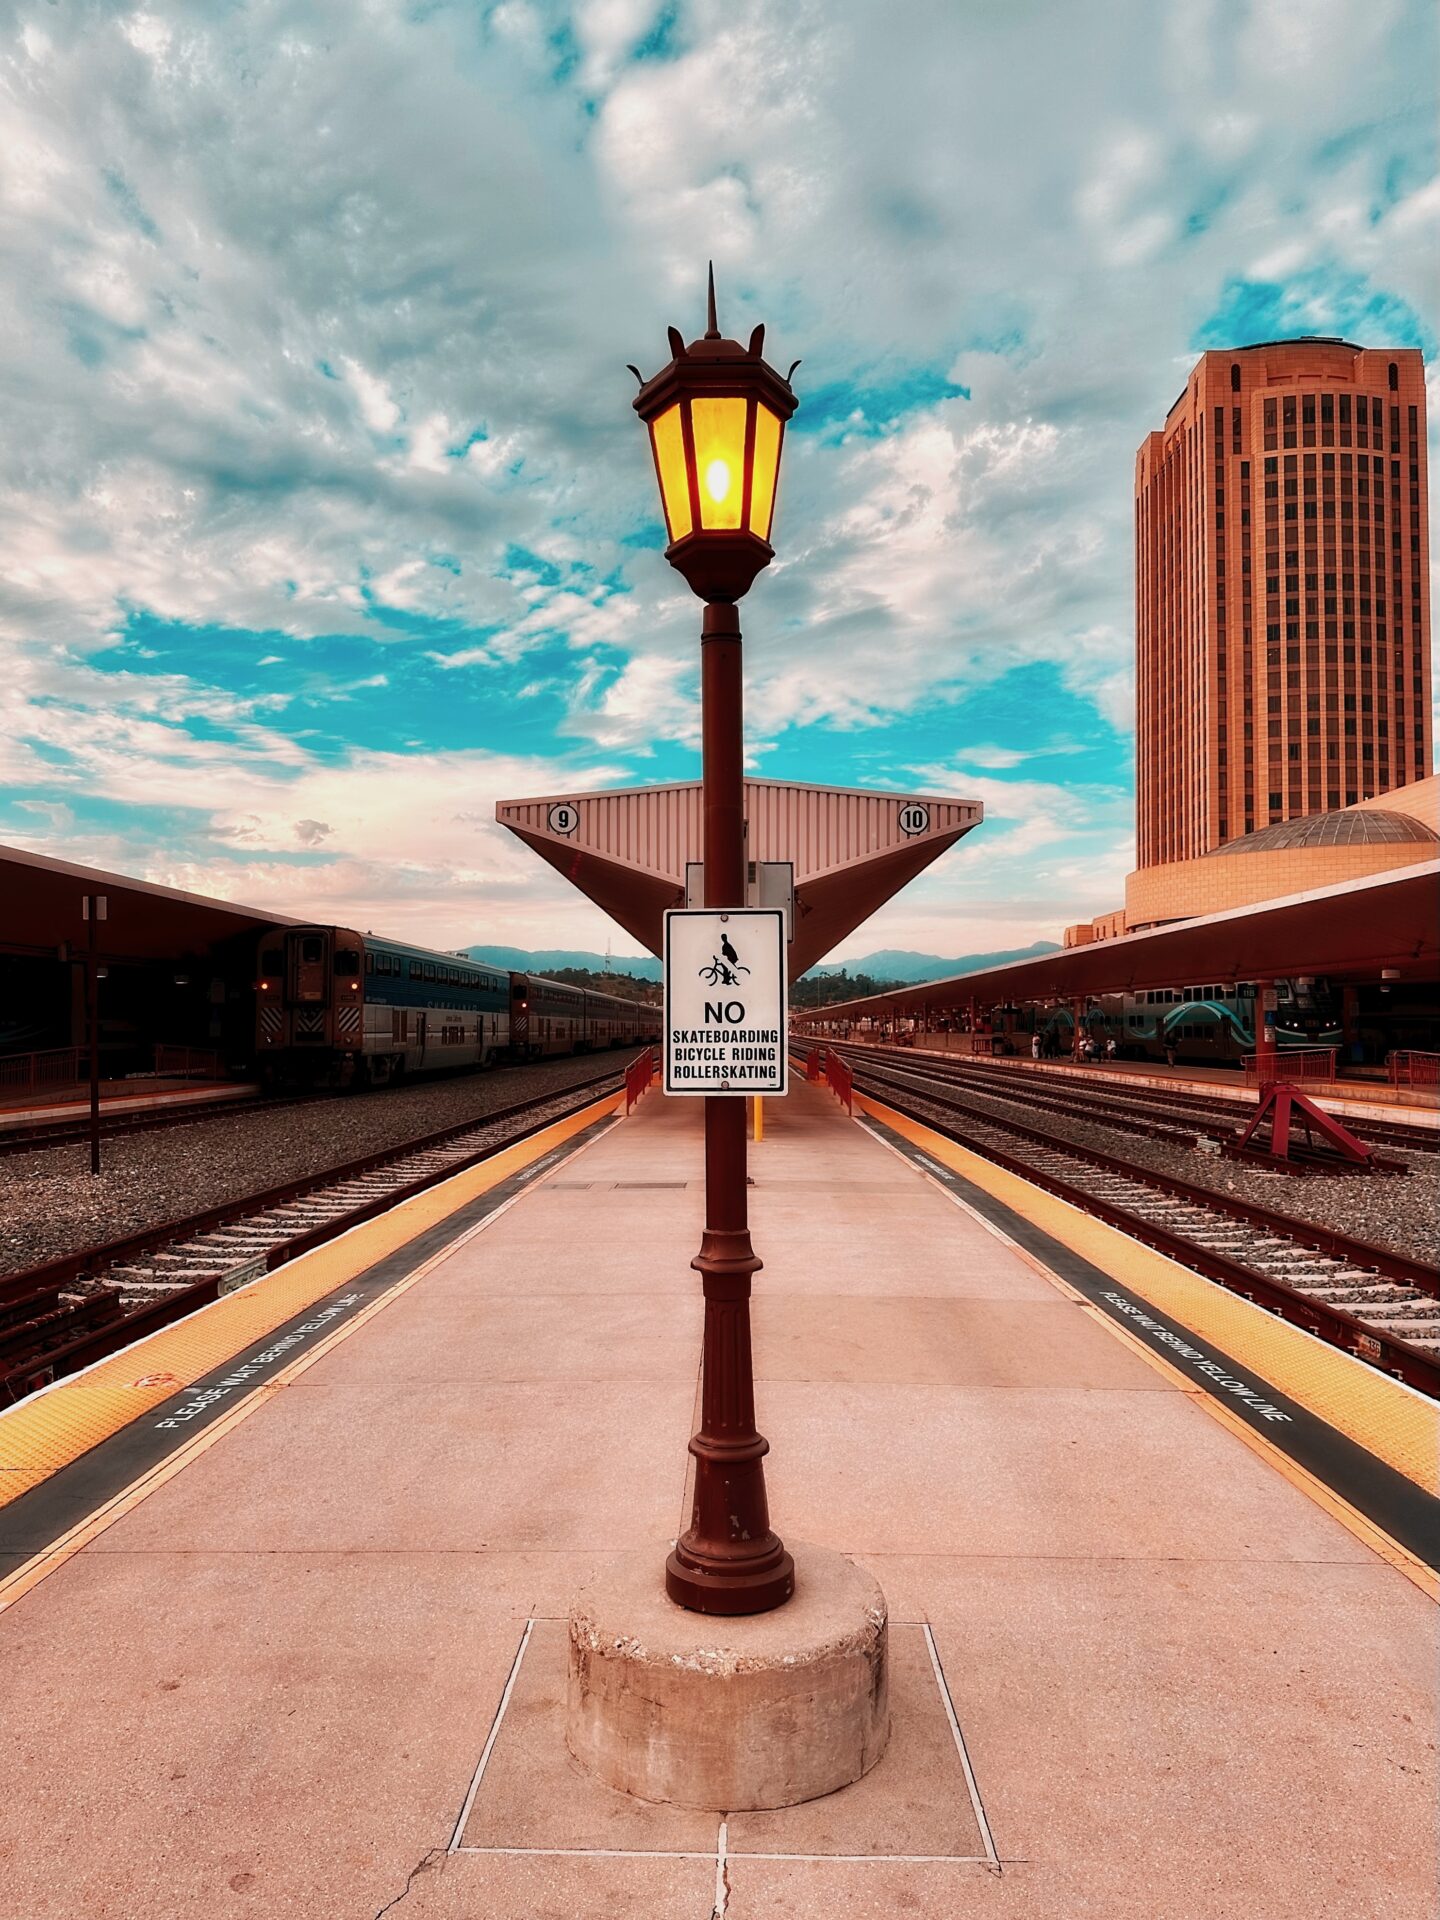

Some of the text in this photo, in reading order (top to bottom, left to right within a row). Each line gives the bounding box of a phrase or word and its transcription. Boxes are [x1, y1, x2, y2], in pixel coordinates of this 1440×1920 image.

[558, 810, 568, 828] 9
[905, 810, 922, 828] 10
[704, 1001, 745, 1024] NO
[672, 1030, 778, 1043] SKATEBOARDING
[675, 1048, 776, 1061] BICYCLE RIDING
[674, 1065, 777, 1078] ROLLERSKATING
[1098, 1291, 1293, 1422] PLEASE WAIT BEHIND YELLOW LINE
[154, 1388, 232, 1428] PLEASE
[216, 1364, 263, 1387] WAIT
[250, 1334, 305, 1363] BEHIND
[292, 1307, 345, 1333] YELLOW
